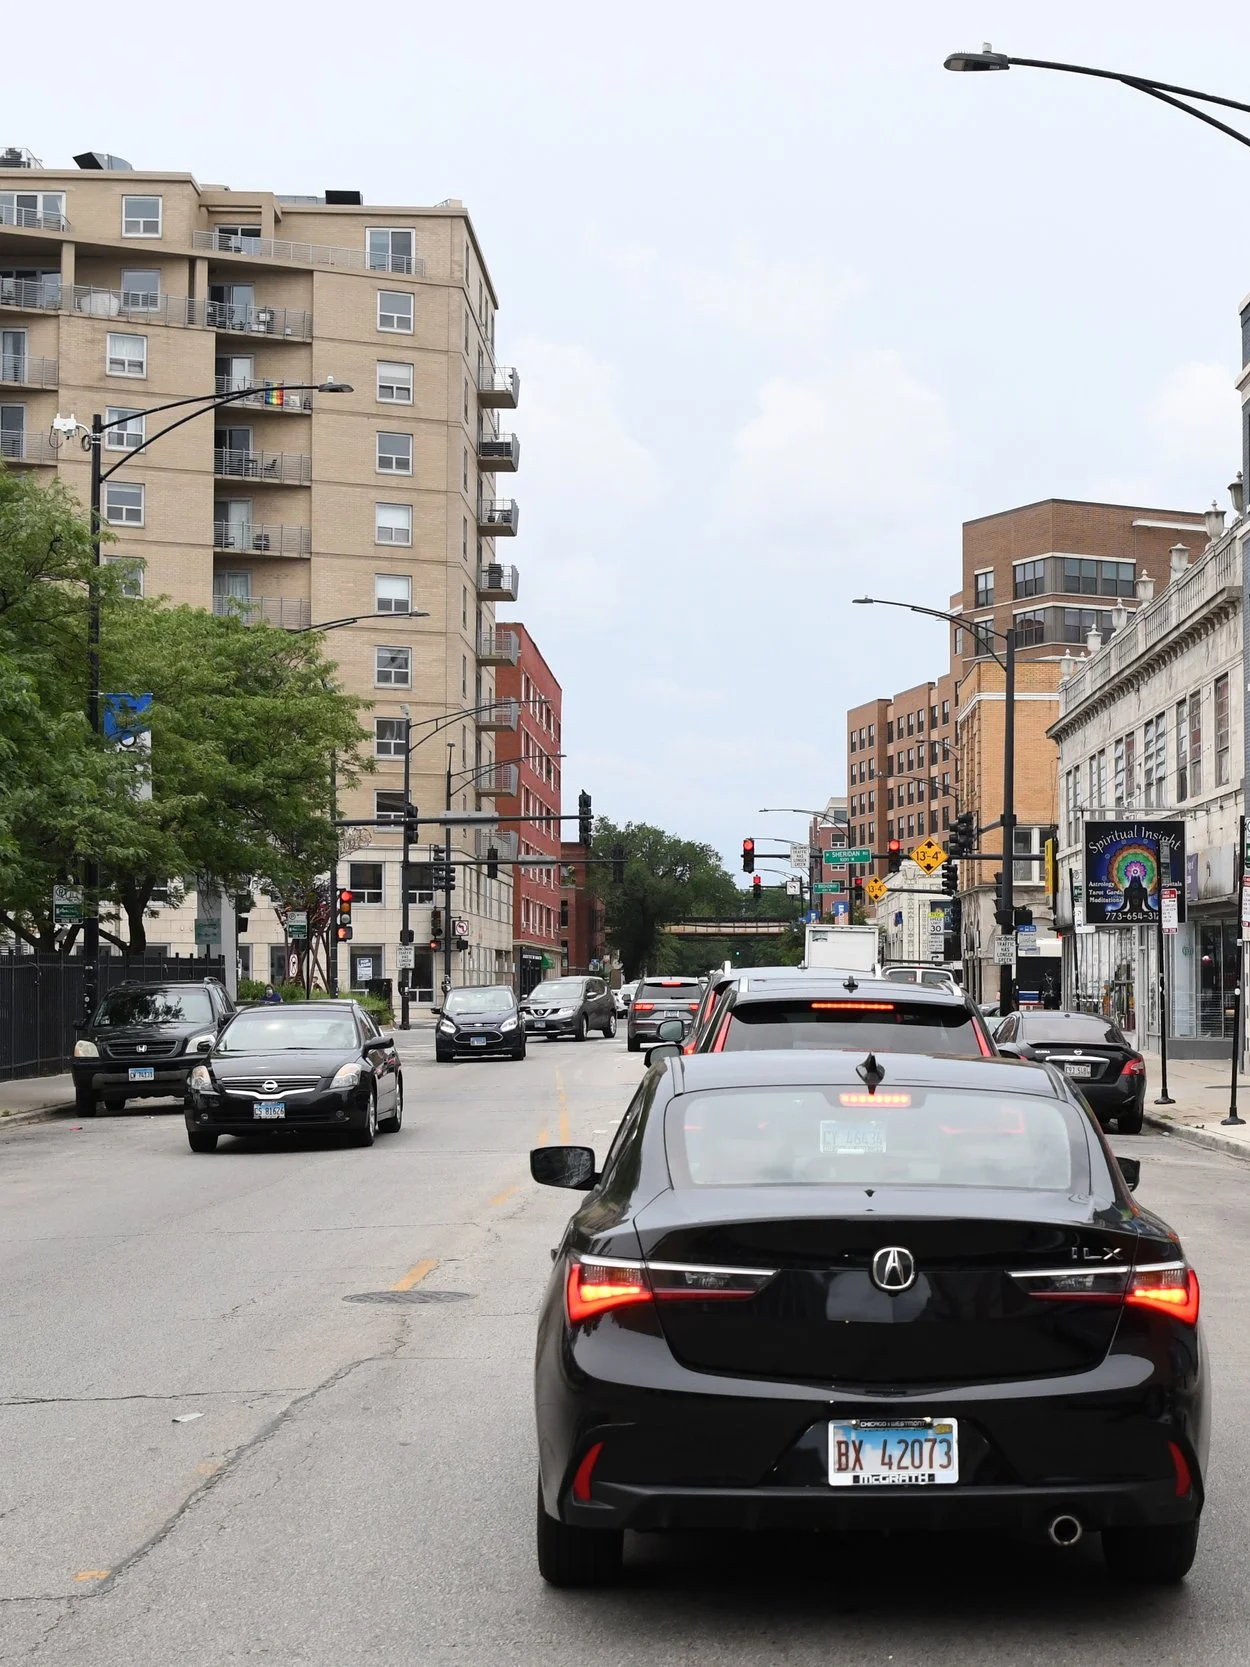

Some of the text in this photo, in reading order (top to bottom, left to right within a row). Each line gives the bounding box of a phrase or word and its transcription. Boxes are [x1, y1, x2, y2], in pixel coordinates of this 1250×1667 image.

[1089, 825, 1181, 853] Spiritual Insight
[1072, 1247, 1123, 1260] ILX
[836, 1438, 951, 1471] BX 42073
